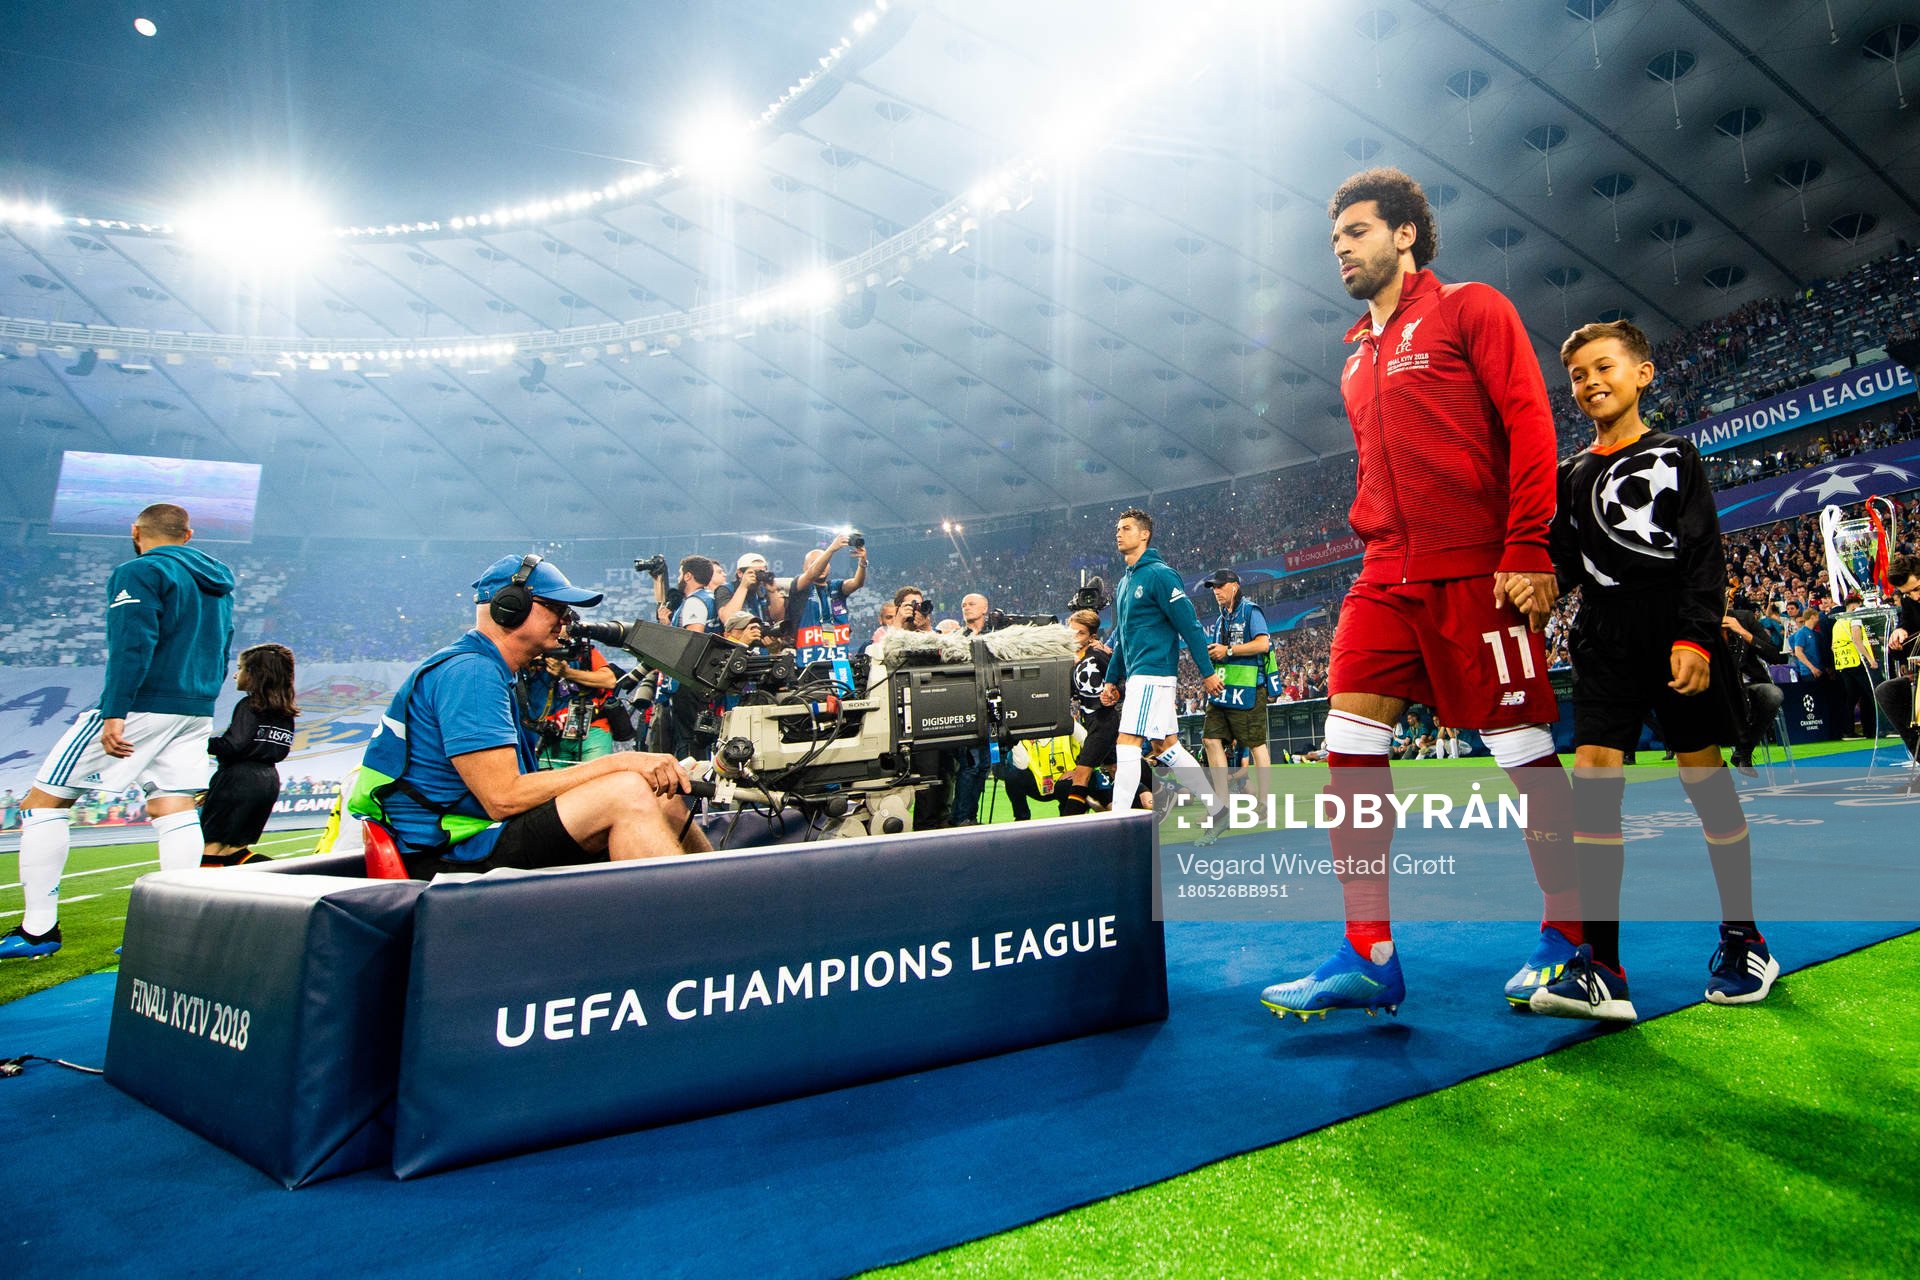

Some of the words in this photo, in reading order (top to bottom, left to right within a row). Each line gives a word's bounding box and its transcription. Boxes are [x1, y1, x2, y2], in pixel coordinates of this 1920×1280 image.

[1414, 352, 1429, 361] 2018
[1684, 399, 1800, 448] HAMPIONS
[1808, 365, 1913, 413] LEAGUE
[804, 626, 850, 644] PHTO
[802, 647, 813, 664] F
[816, 646, 847, 661] 245
[1482, 624, 1536, 684] 11
[1270, 674, 1280, 692] F
[848, 701, 872, 709] SONY
[1232, 688, 1245, 705] K
[922, 715, 964, 727] DIGISUPER
[966, 713, 977, 723] 95
[1005, 710, 1018, 719] HD
[496, 988, 648, 1047] UEFA
[666, 941, 953, 1020] CHAMPIONS
[971, 914, 1118, 971] LEAGUE
[130, 978, 168, 1024] FINAL
[170, 991, 211, 1037] KYIV
[209, 1003, 250, 1051] 2018
